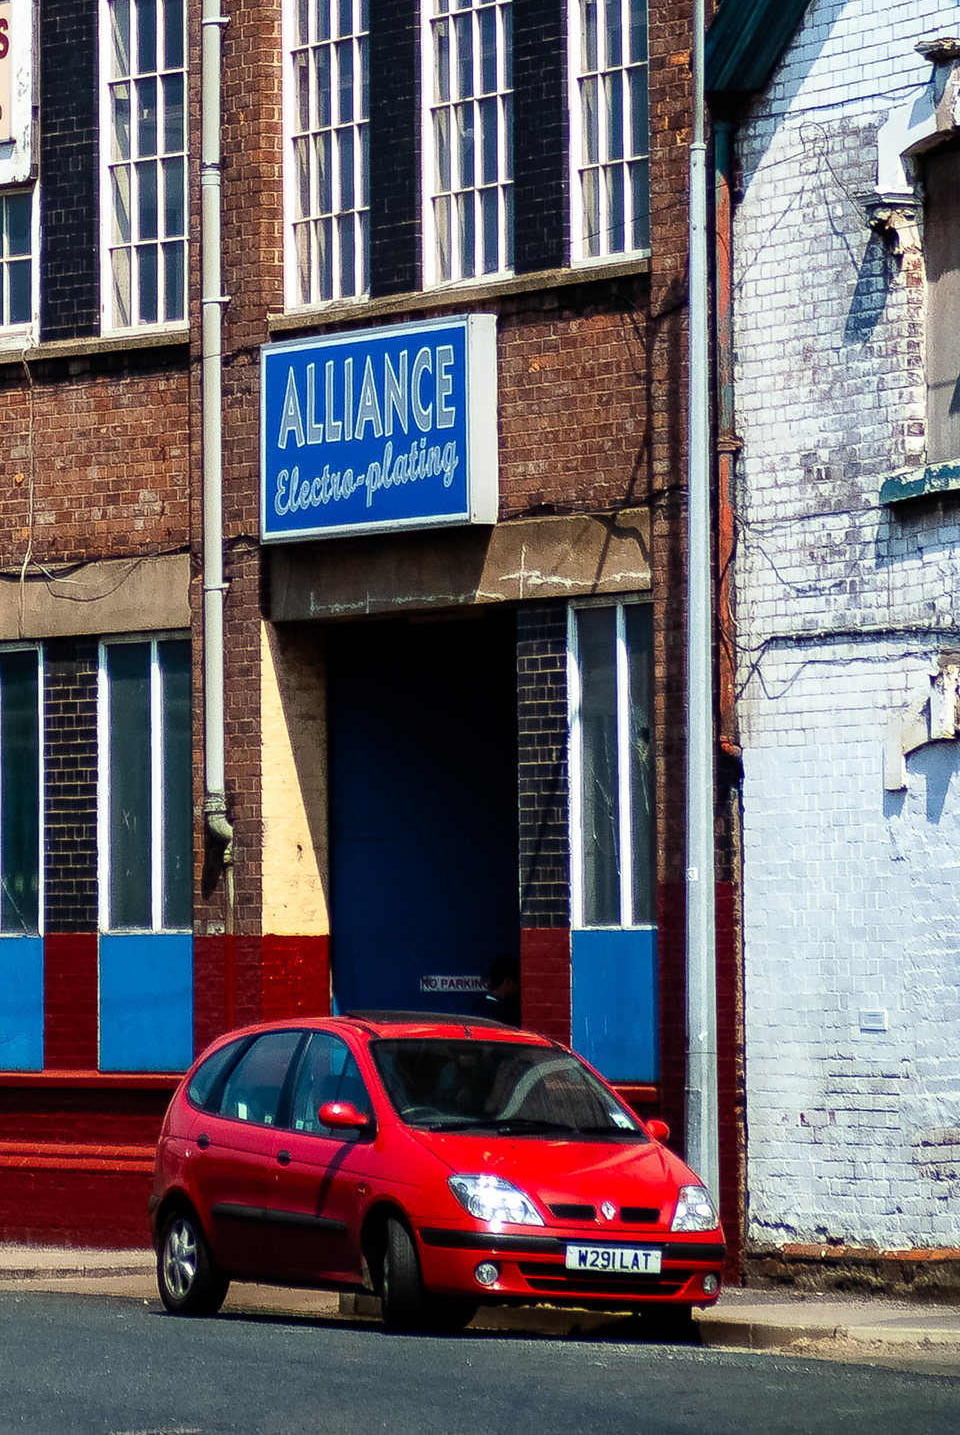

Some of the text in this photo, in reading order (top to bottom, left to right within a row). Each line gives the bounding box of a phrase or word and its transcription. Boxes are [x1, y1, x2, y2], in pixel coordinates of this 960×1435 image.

[277, 344, 456, 449] ALLIANCE
[274, 437, 459, 516] Electro-plating
[421, 978, 437, 989] NO
[620, 1252, 651, 1270] LAT
